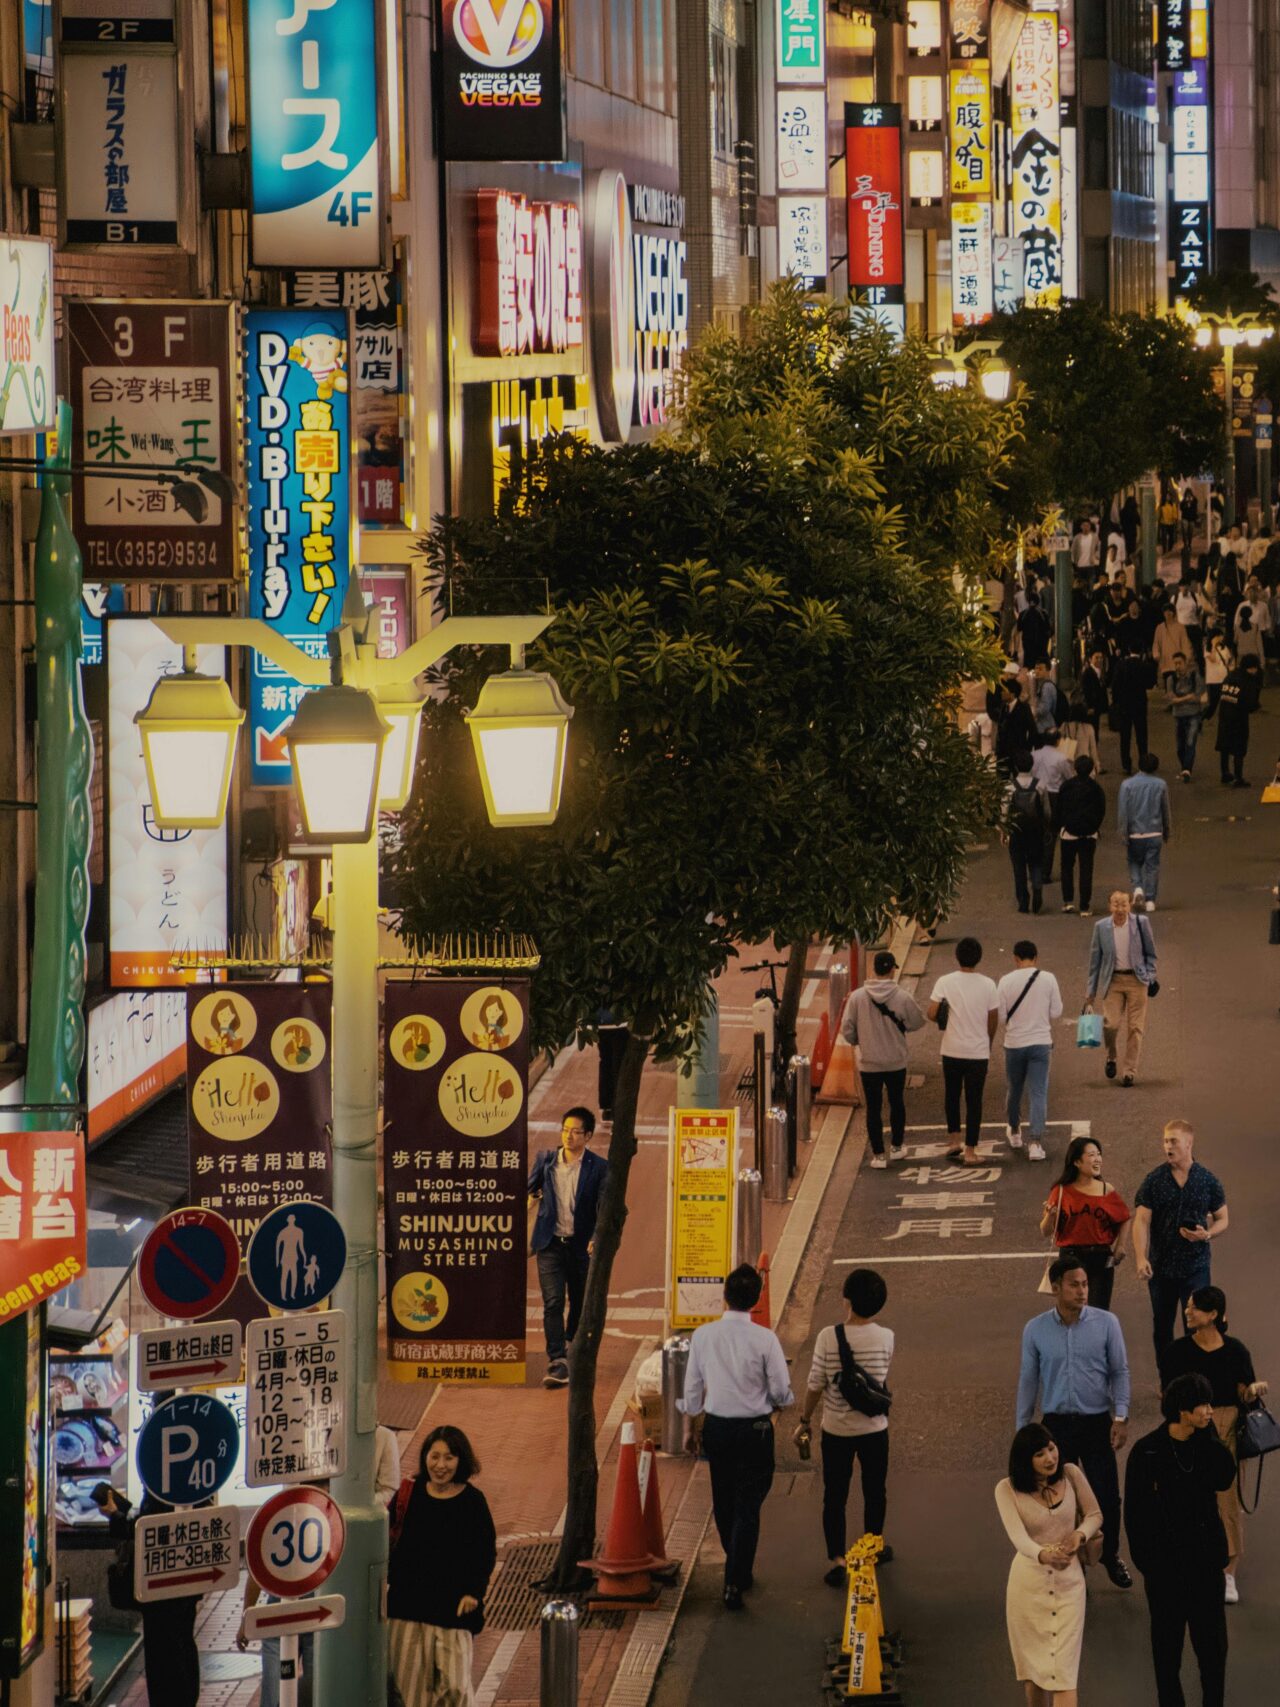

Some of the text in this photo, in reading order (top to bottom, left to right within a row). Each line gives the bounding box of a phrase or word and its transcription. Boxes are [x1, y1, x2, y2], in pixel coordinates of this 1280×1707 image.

[97, 20, 140, 40] 2F
[460, 79, 542, 94] VEGAS
[460, 92, 542, 107] VEGAS
[862, 108, 883, 125] 2F
[102, 63, 130, 214] ガラスの部屋
[954, 180, 968, 190] 4F
[326, 190, 374, 228] 4F
[1013, 128, 1060, 290] 金の蔵
[106, 223, 139, 243] B1
[868, 213, 883, 277] DINING
[1181, 208, 1203, 288] ZARA
[634, 233, 687, 331] VEGAS
[866, 286, 886, 304] 1F
[4, 304, 31, 363] Peas
[89, 376, 213, 403] 台湾料理
[86, 416, 131, 463] 味
[175, 419, 217, 465] 王
[104, 487, 184, 513] 小酒
[361, 479, 394, 511] 1階
[88, 540, 218, 568] TEL(3352)9534
[158, 868, 181, 931] うどん
[196, 1151, 328, 1175] 歩行者用道路
[392, 1150, 521, 1169] 歩行者用道路
[399, 1214, 513, 1234] SHINJUKU
[398, 1238, 514, 1252] MUSASHINO
[423, 1253, 489, 1266] STREET
[29, 1256, 81, 1295] Peas
[393, 1342, 519, 1361] 新宿武蔵野商栄会
[416, 1365, 490, 1379] 路上喫煙禁止
[161, 1425, 200, 1494] P
[188, 1458, 216, 1490] 40
[270, 1517, 324, 1568] 30
